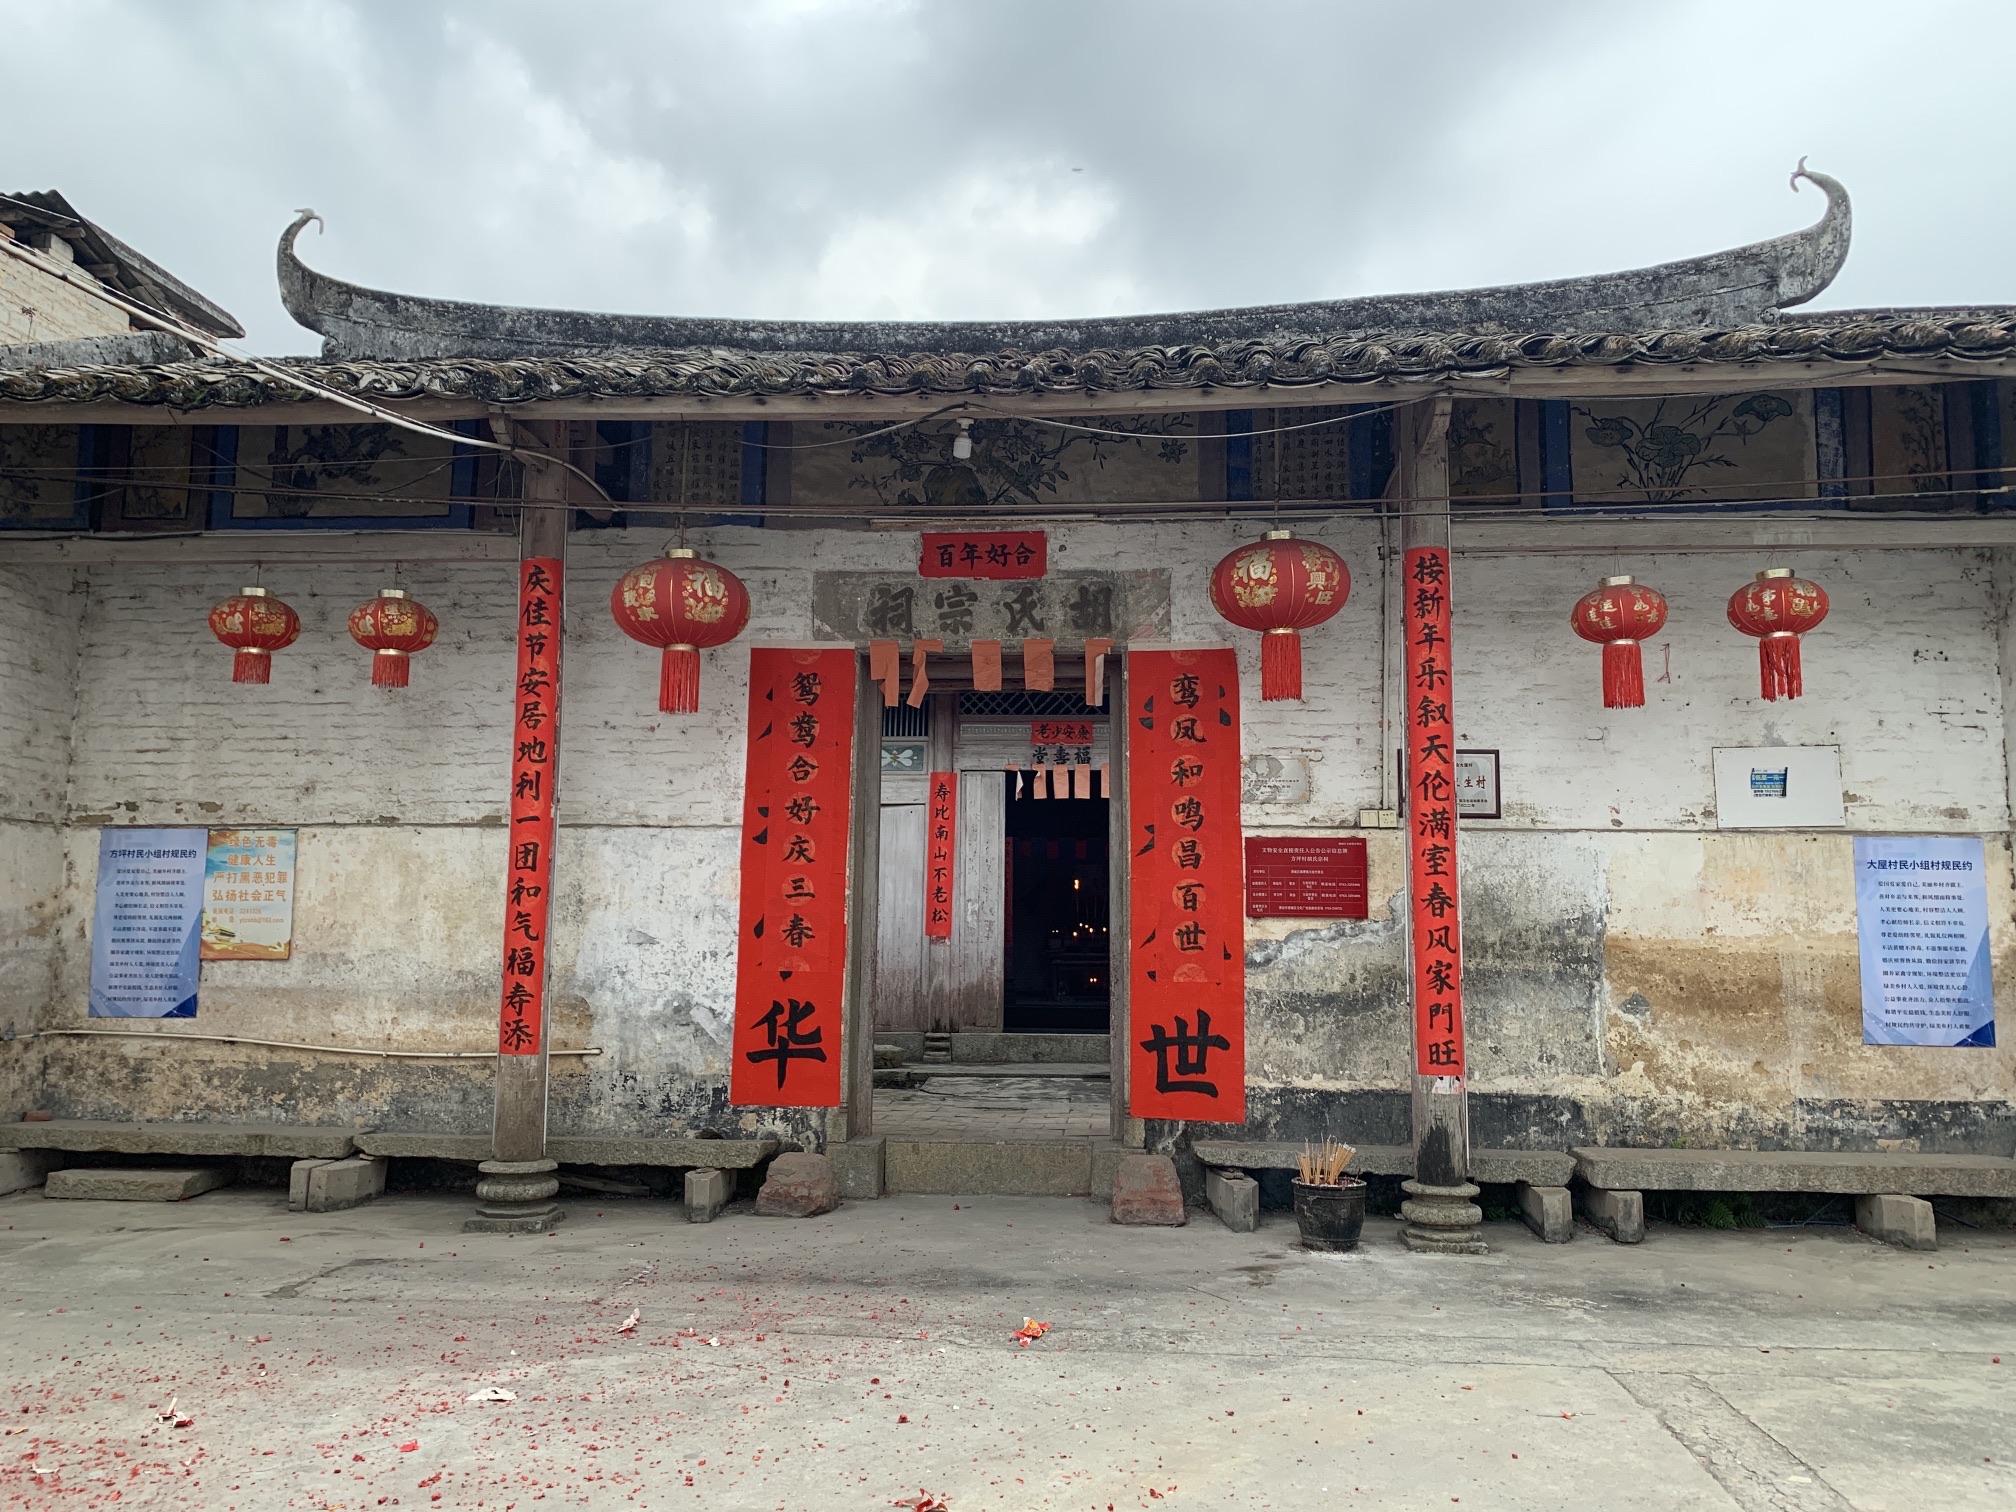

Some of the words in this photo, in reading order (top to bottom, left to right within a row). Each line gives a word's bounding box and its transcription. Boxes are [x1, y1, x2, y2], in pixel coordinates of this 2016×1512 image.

[936, 541, 1037, 570] 百年好合
[868, 585, 1113, 636] 胡氏宗祠
[502, 563, 555, 1051] 庆佳节安居地利一团和气福寿添
[782, 671, 821, 948] 鸳鸯合好庆三春
[1171, 672, 1207, 952] 鸾凤和鸣昌百世
[228, 835, 278, 848] 绿色无毒
[109, 850, 197, 859] 方坪村民小组村规民约
[228, 853, 276, 866] 健康人生
[932, 782, 951, 924] 寿比南山不老松
[1867, 860, 1972, 871] 大屋村民小组村规民约
[213, 871, 288, 884] 严打黑恶犯罪
[212, 889, 286, 902] 弘扬社会正气
